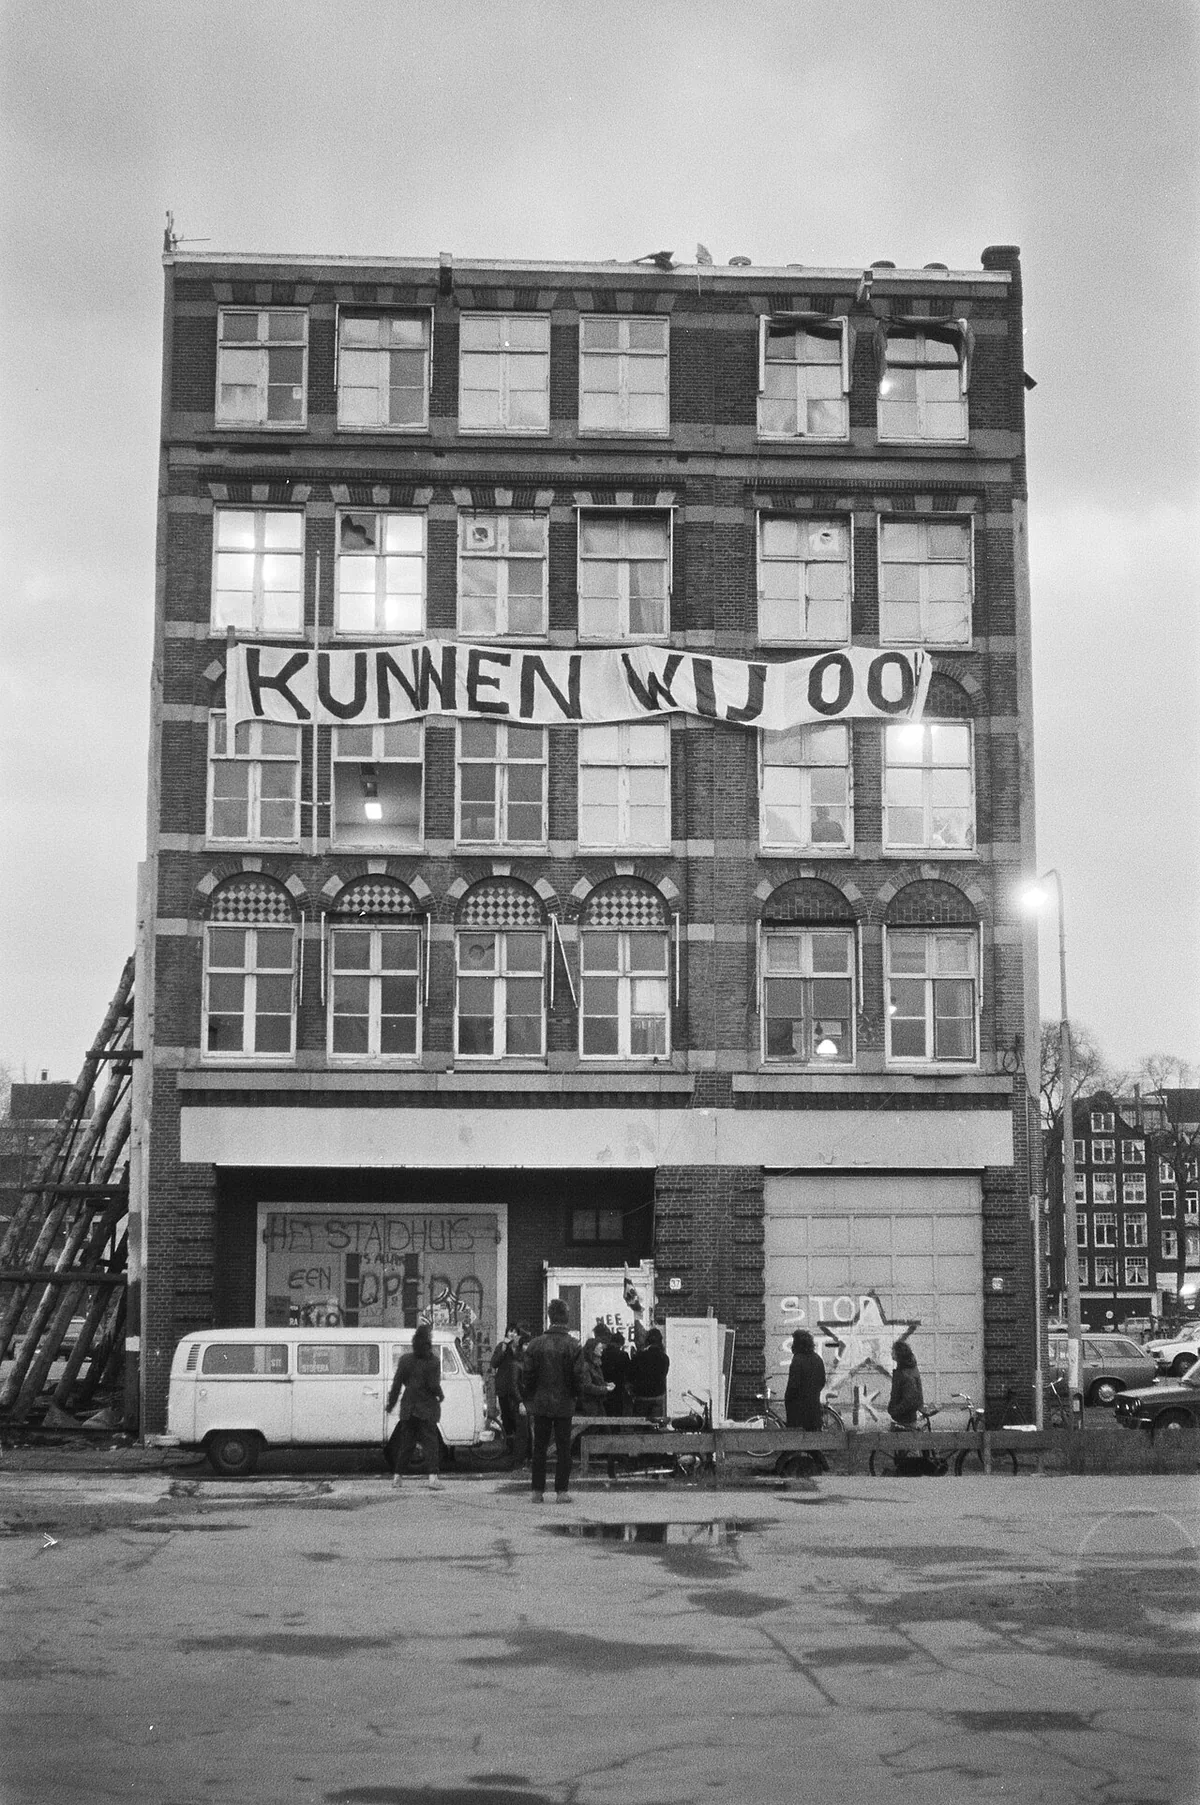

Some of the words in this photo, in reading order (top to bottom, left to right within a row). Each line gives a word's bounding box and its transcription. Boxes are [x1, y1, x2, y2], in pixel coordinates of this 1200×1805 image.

[246, 648, 582, 719] KUNNEN
[621, 652, 767, 722] WIJ
[269, 1215, 313, 1252] HET
[324, 1218, 475, 1251] STADHUIS
[288, 1265, 332, 1291] EEN
[670, 1279, 680, 1288] 37
